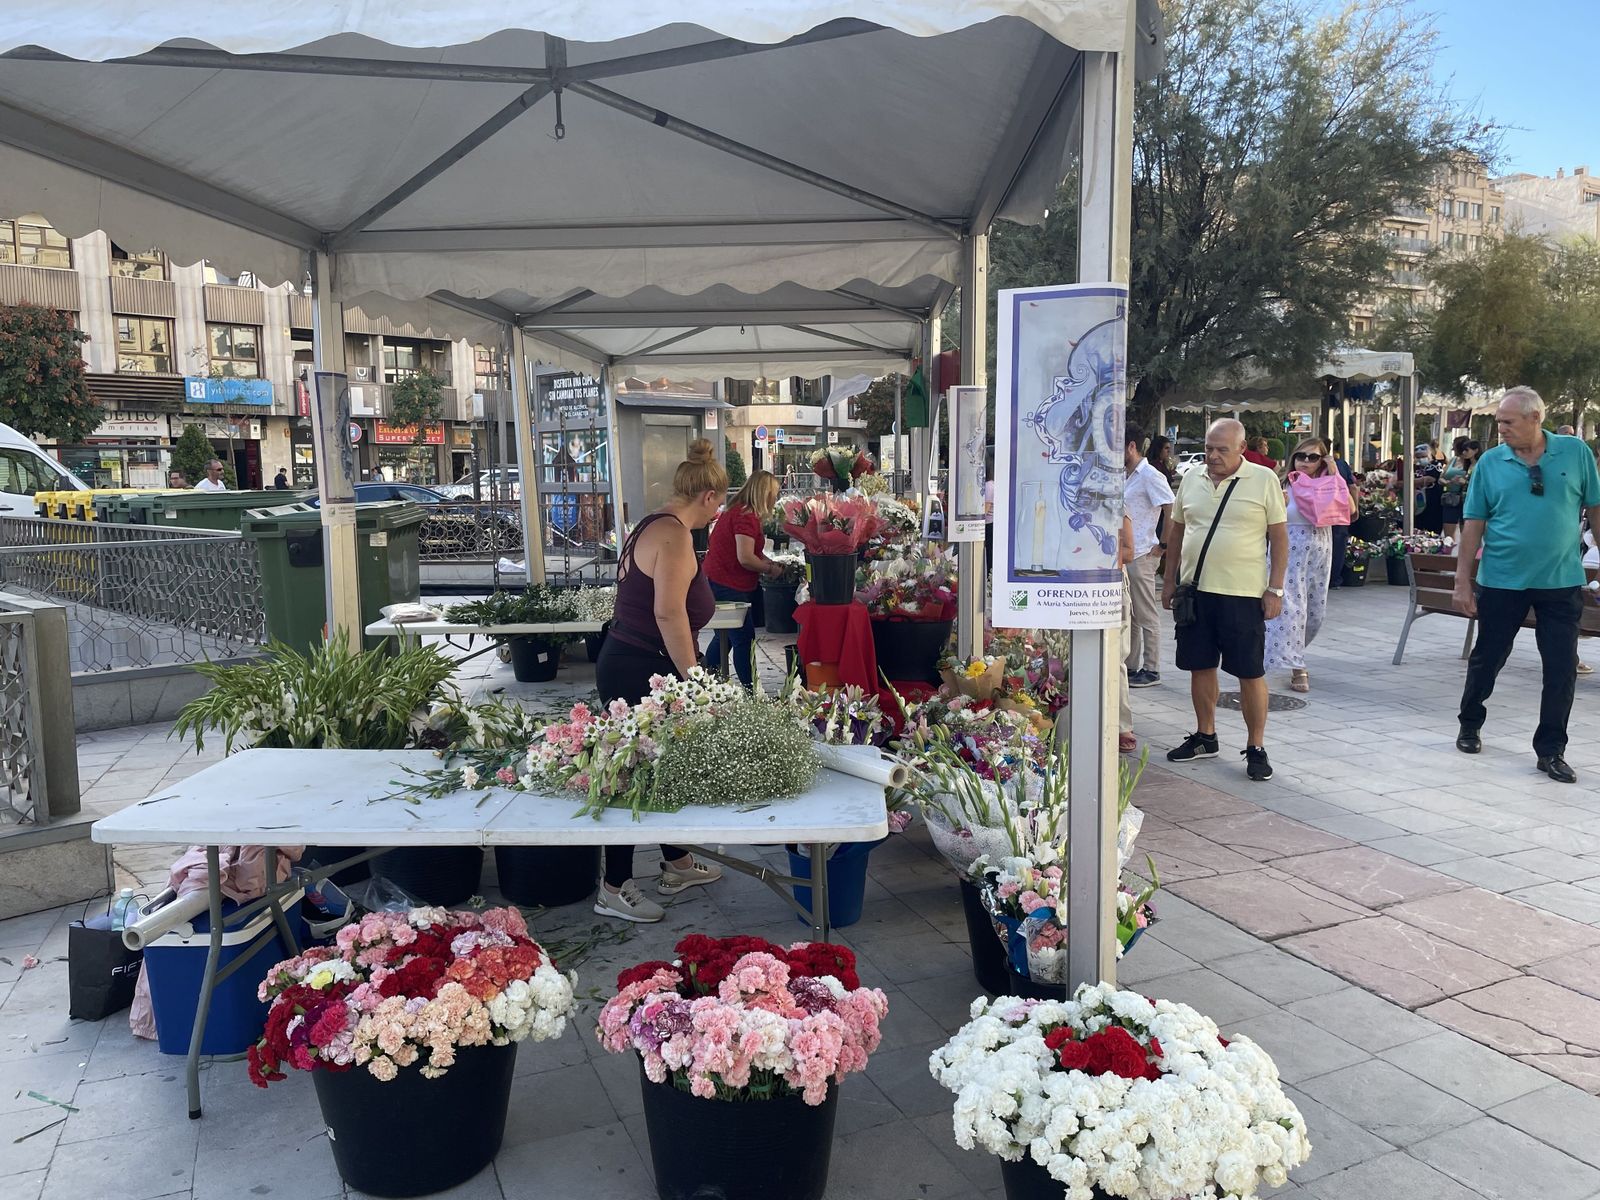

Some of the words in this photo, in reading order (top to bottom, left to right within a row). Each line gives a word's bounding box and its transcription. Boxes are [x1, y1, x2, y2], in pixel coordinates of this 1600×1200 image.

[554, 378, 572, 388] DISFRUTA
[573, 377, 581, 387] UNA
[557, 389, 574, 400] CAMBIAR
[583, 387, 598, 397] PLANES
[1037, 588, 1089, 598] OFRENDA
